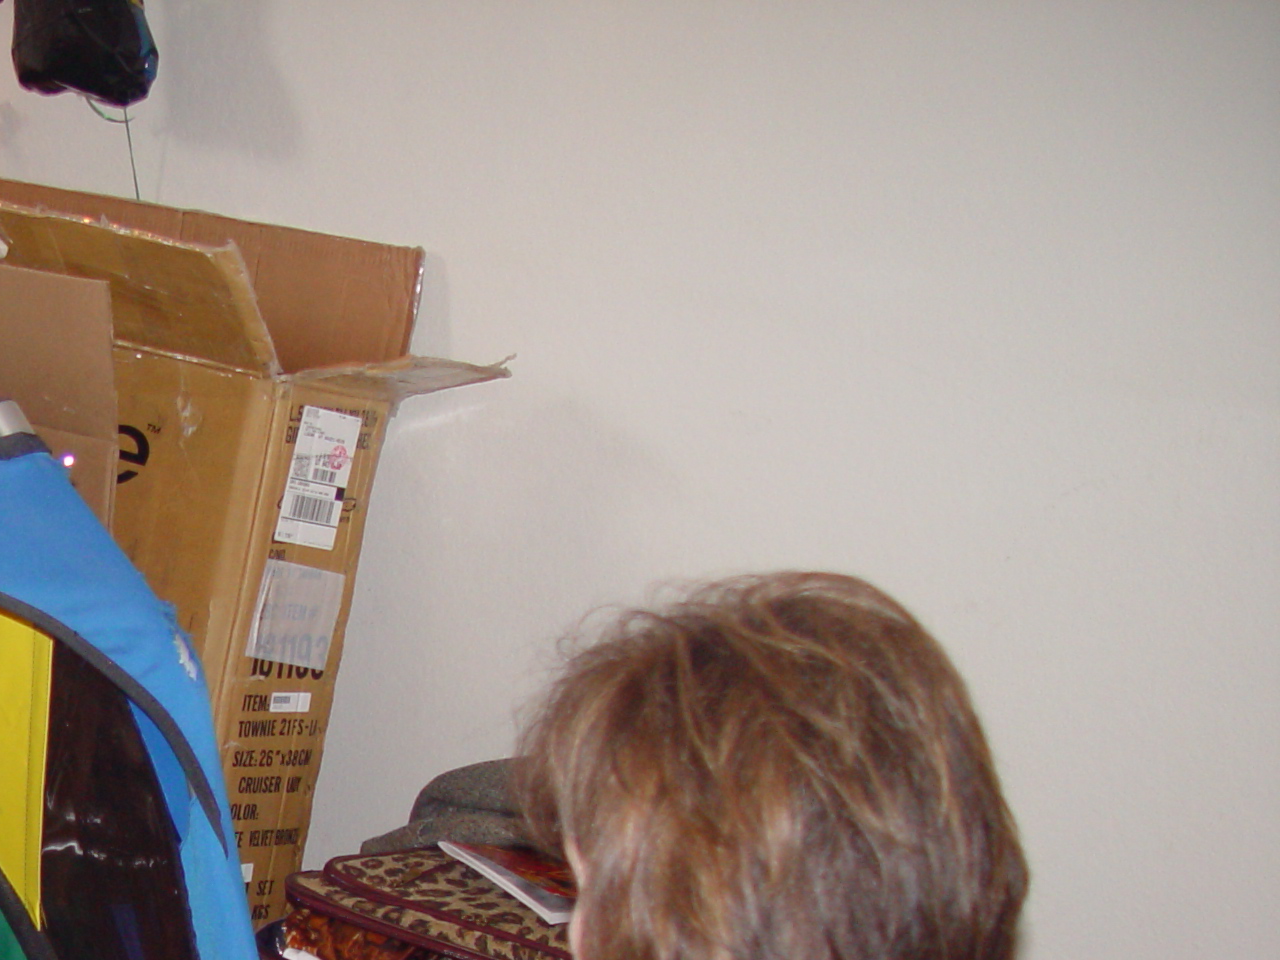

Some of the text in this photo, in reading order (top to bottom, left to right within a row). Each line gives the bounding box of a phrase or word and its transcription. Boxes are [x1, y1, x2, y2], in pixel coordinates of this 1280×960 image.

[242, 694, 269, 711] ITEM:
[238, 720, 277, 738] TOWNIE
[232, 750, 257, 767] SIZE:
[238, 776, 282, 793] CRUISER
[230, 804, 259, 821] OLOR:
[249, 829, 274, 847] VELVET
[256, 880, 275, 896] SET
